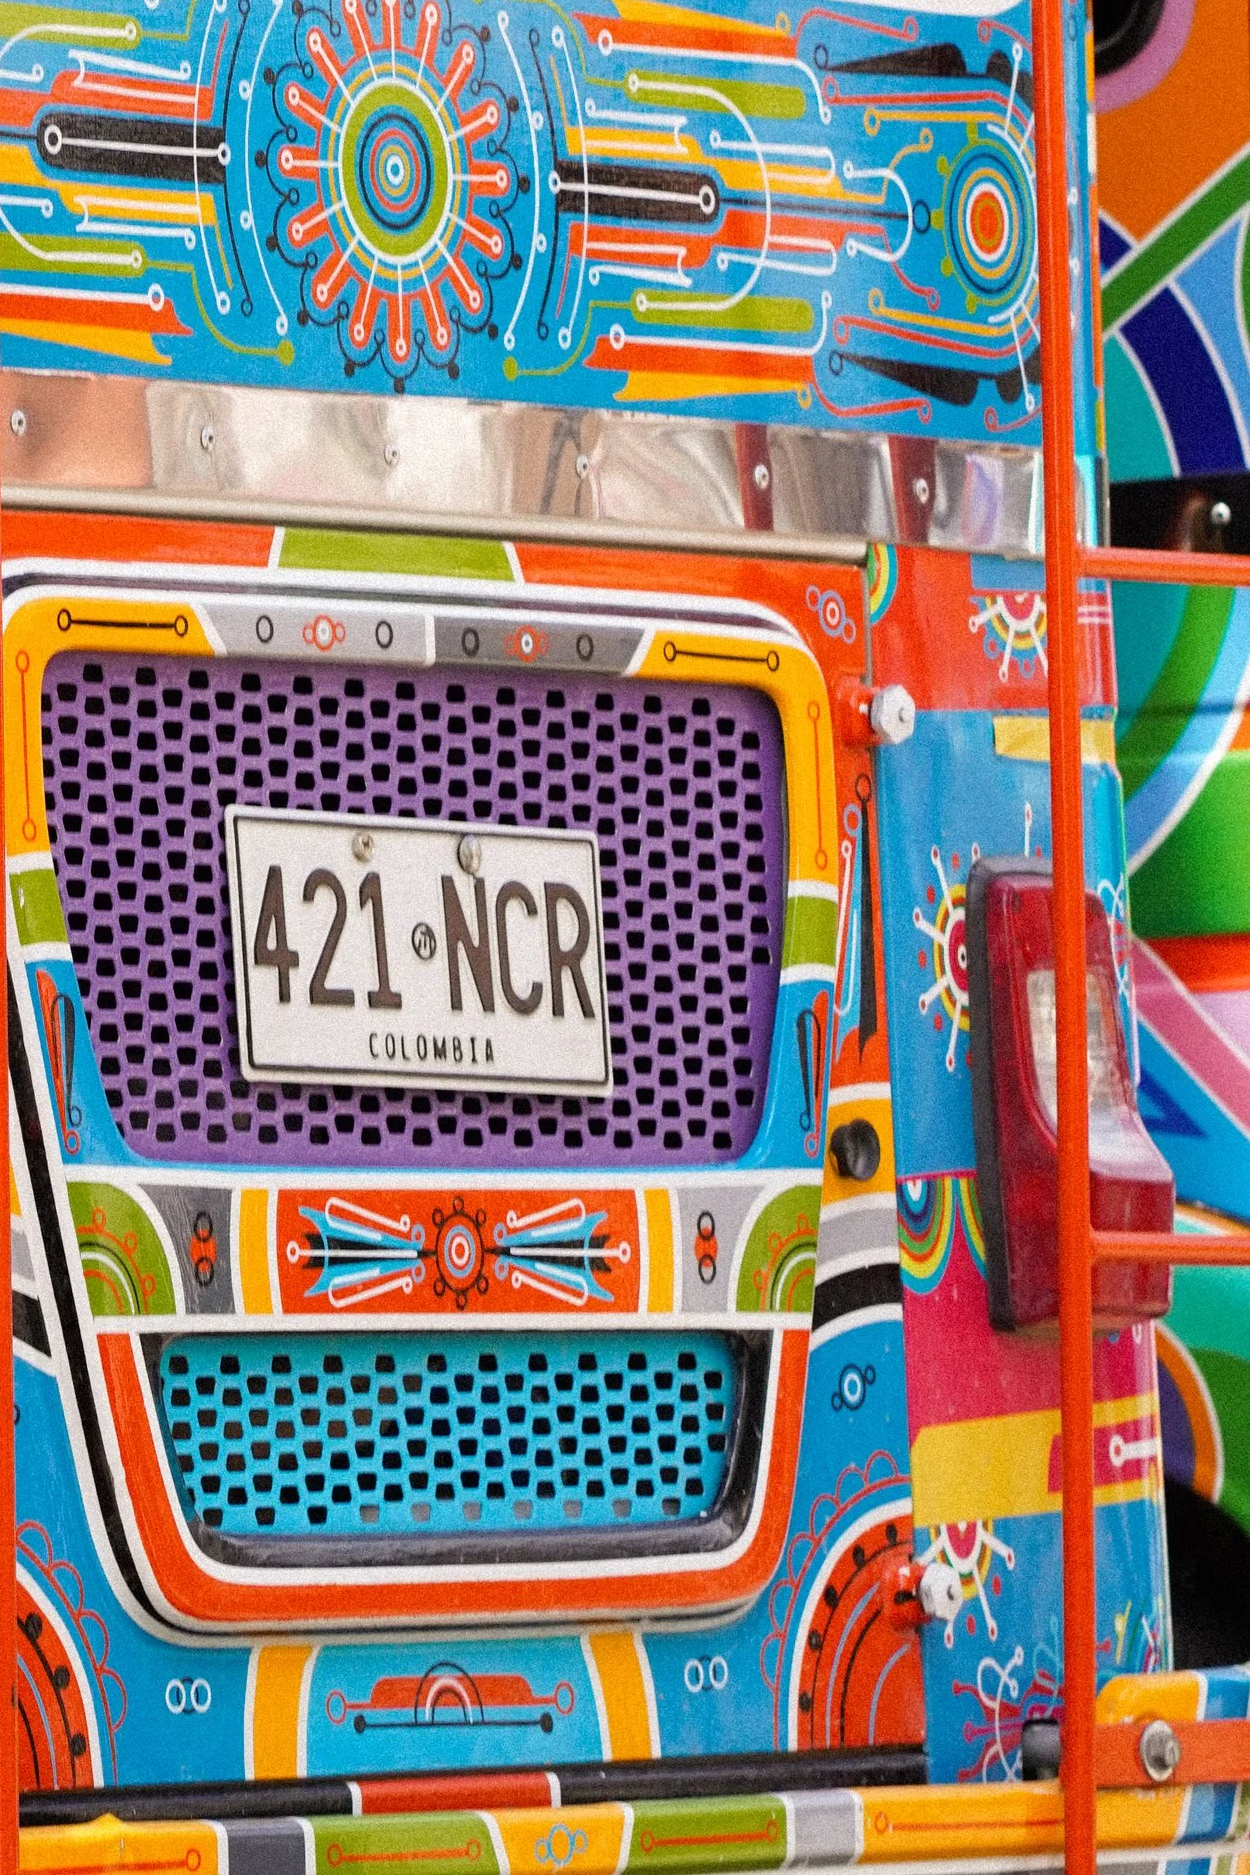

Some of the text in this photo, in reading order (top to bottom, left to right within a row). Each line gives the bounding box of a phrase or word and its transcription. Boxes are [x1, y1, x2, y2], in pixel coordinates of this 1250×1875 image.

[254, 864, 597, 1019] 421 NCR
[368, 1032, 496, 1064] COLOMBIA
